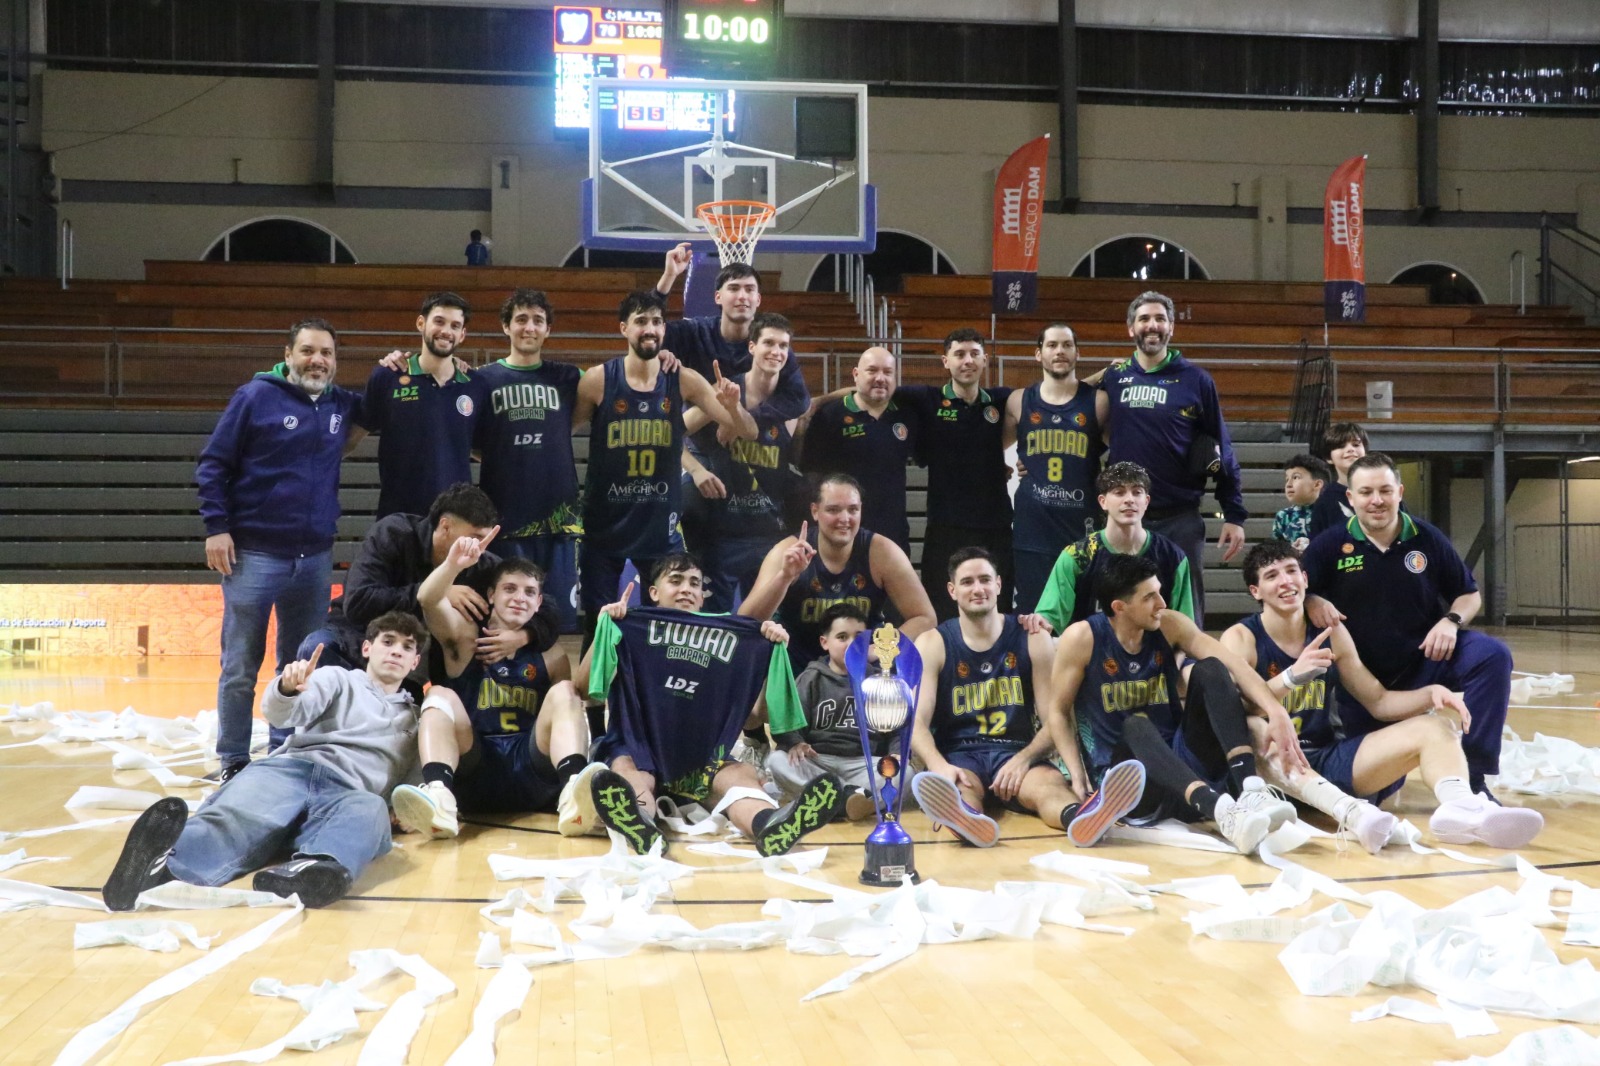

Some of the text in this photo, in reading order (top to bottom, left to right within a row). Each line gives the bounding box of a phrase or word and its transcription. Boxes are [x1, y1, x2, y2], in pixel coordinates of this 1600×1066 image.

[684, 13, 769, 43] 10:00
[640, 65, 650, 78] 4
[631, 107, 661, 119] 5 5
[1350, 182, 1360, 213] DAM
[1024, 166, 1040, 257] ESPACIO DAM
[392, 386, 419, 398] LDZ
[491, 384, 561, 414] CIUDAD
[1120, 386, 1168, 405] CIUDAD
[508, 408, 545, 421] CAMPANA
[937, 409, 959, 417] LDZ
[514, 433, 543, 446] LDZ
[607, 419, 672, 448] CIUDAD
[842, 424, 864, 436] LDZ
[1026, 429, 1088, 458] CIUDAD
[627, 450, 656, 477] 10
[1047, 457, 1063, 482] 8
[607, 481, 669, 496] AMEGHINO
[1337, 555, 1364, 570] LDZ
[649, 620, 738, 663] CIUDAD
[667, 646, 710, 668] CAMPANA
[664, 676, 700, 694] LDZ
[952, 676, 1024, 716] CIUDAD
[499, 712, 520, 733] 5
[976, 711, 1007, 735] 12
